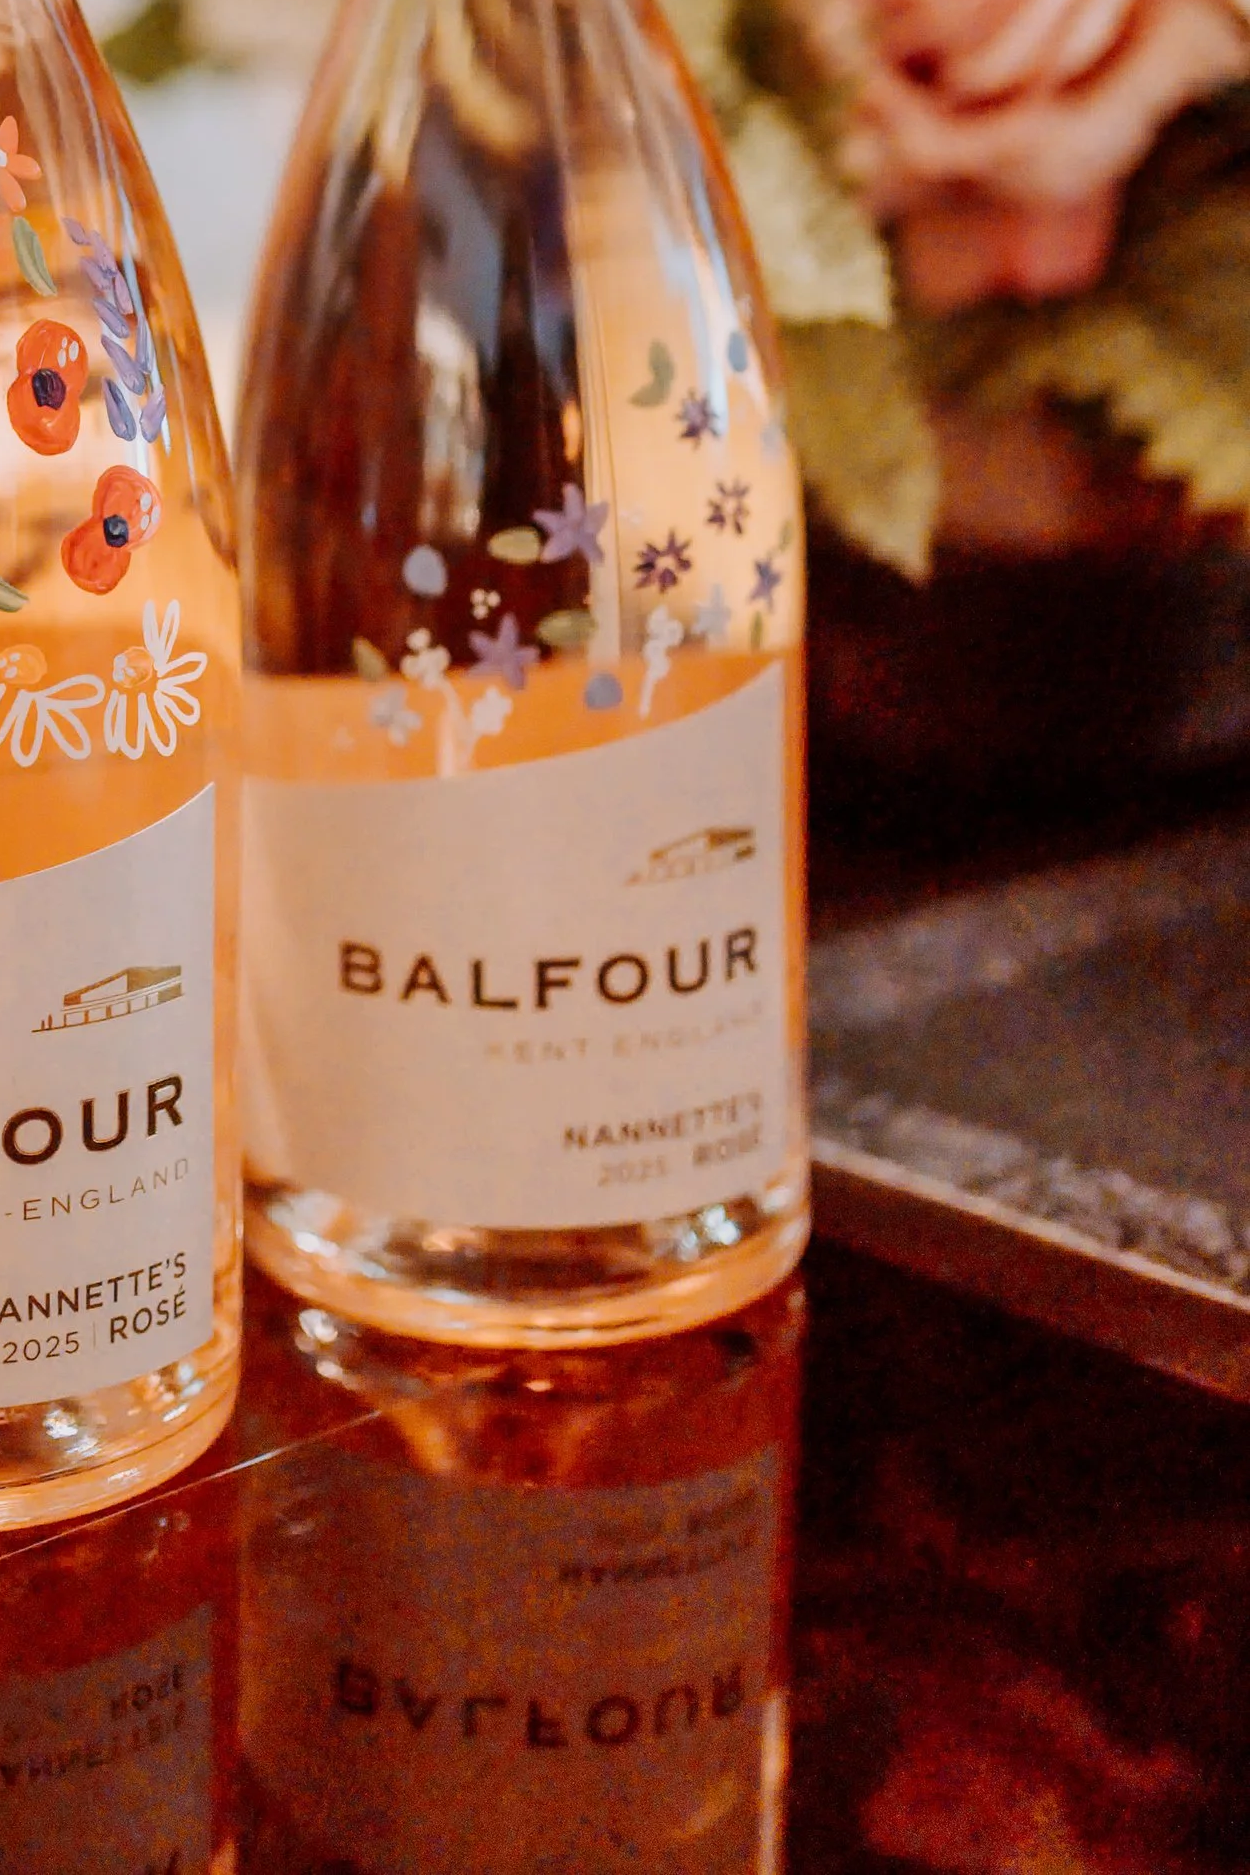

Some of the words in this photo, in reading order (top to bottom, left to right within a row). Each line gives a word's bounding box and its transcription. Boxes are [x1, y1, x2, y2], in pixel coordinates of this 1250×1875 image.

[338, 924, 760, 1011] BALFOUR
[2, 1331, 80, 1365] 2025
[109, 1285, 187, 1344] ROSÉ
